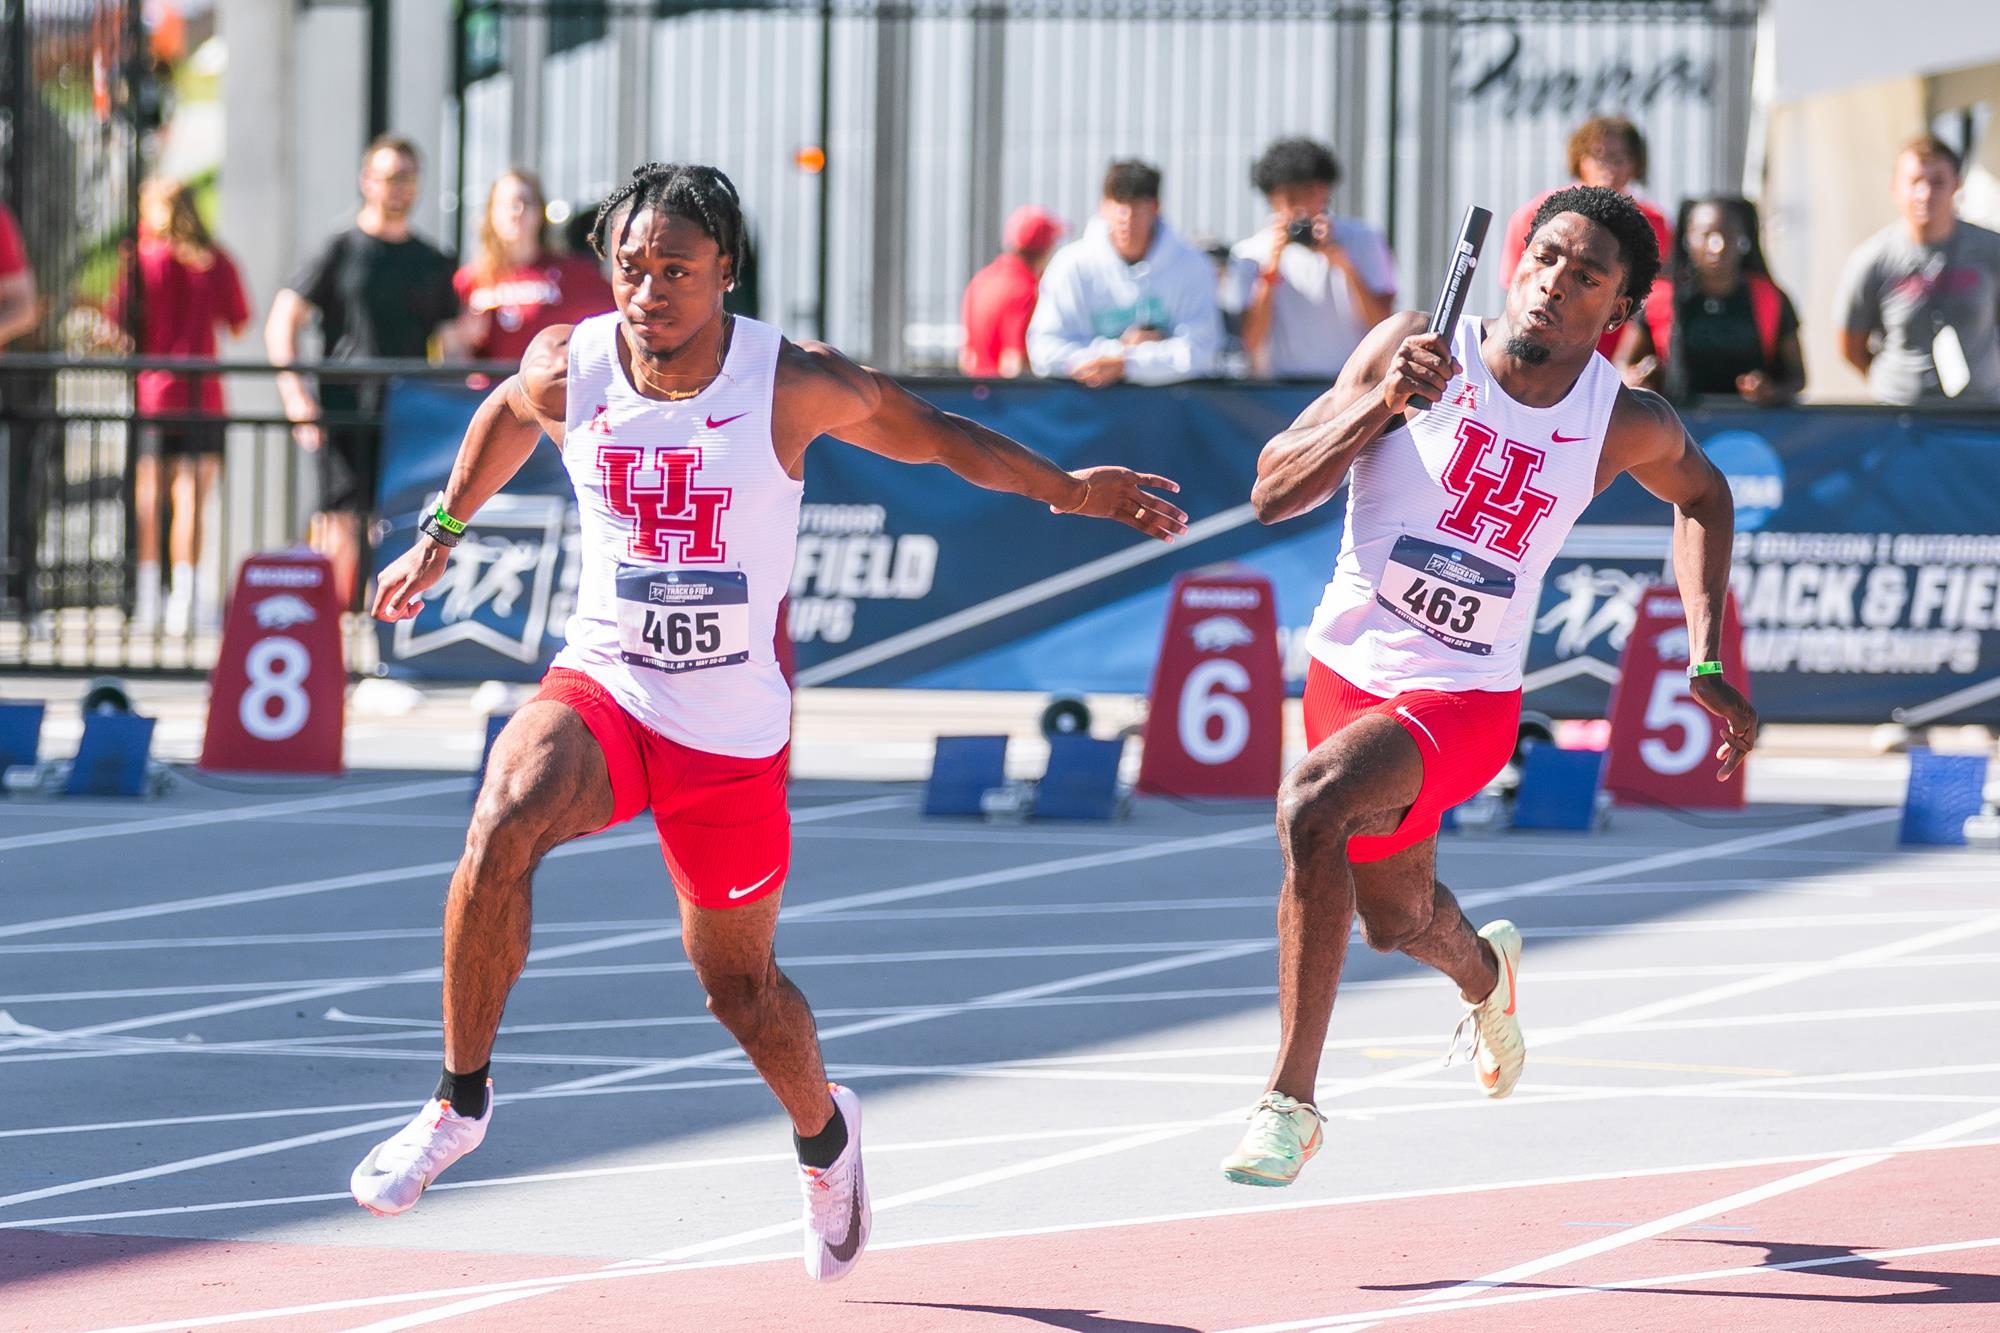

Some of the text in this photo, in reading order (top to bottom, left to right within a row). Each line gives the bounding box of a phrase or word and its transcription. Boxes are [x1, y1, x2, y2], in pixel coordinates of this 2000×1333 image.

[789, 534, 939, 599] FIELD
[1893, 534, 2000, 565] OUTDOO
[667, 586, 688, 595] TRACK
[694, 586, 714, 595] FIELD
[1402, 577, 1481, 634] 463
[1730, 563, 1862, 627] RACK
[1911, 564, 2000, 630] FIE
[642, 610, 721, 656] 465
[239, 636, 312, 742] 8
[1177, 658, 1251, 765] 6
[1638, 671, 1712, 775] 5
